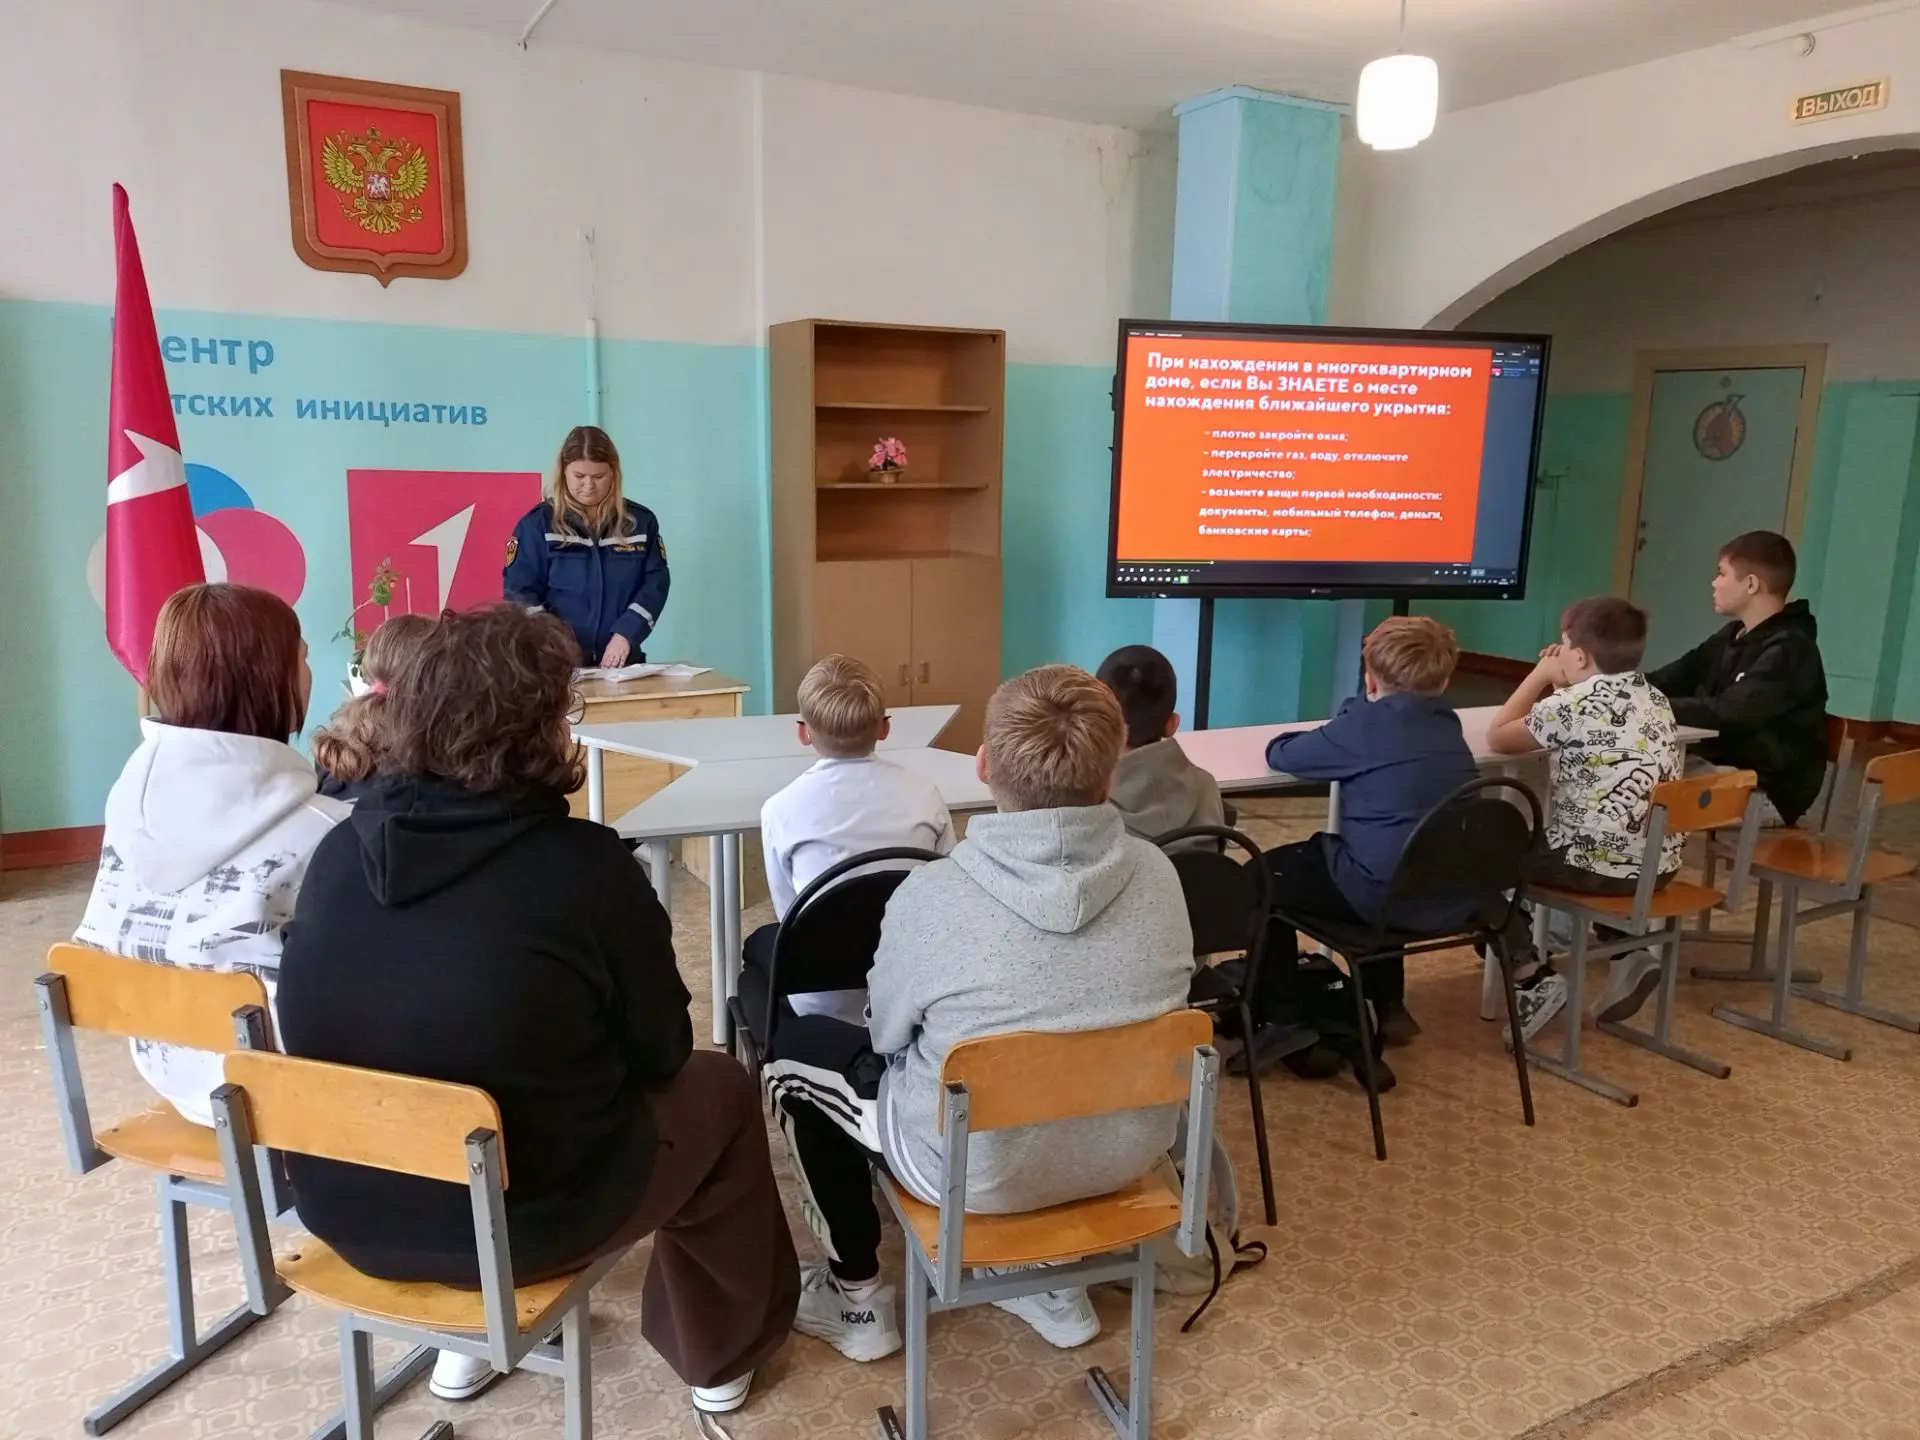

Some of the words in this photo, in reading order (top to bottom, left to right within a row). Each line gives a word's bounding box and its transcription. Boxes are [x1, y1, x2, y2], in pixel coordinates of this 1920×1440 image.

[1801, 85, 1877, 117] ВЫХОД
[1147, 352, 1184, 371] При
[1188, 357, 1299, 373] нахождении
[1303, 362, 1313, 373] в
[1316, 362, 1472, 380] многоквартирном
[1145, 376, 1195, 390] доме,
[1199, 377, 1242, 390] если
[1246, 375, 1272, 391] Вы
[1276, 376, 1349, 393] ЗНАЕТЕ
[1353, 383, 1364, 393] о
[1367, 383, 1418, 395] месте
[170, 394, 274, 418] тских
[295, 398, 488, 428] инициатив
[1145, 396, 1255, 411] нахождения
[1258, 395, 1370, 412] ближайшего
[1373, 402, 1452, 417] укрытия:
[1211, 430, 1256, 439] плотно
[1259, 429, 1314, 442] закройте
[1211, 448, 1284, 461] перекройте
[1343, 453, 1408, 462] отключите
[1202, 469, 1296, 480] электричество;
[1208, 489, 1264, 497] возьмите
[1267, 490, 1299, 499] вещи
[1301, 488, 1345, 501] первой
[1272, 506, 1341, 518] мобильный
[1198, 524, 1270, 536] банковские
[1586, 729, 1620, 740] TIMES
[1586, 738, 1616, 748] GOOD
[1598, 767, 1654, 821] PLAY
[840, 1309, 876, 1324] HOKA
